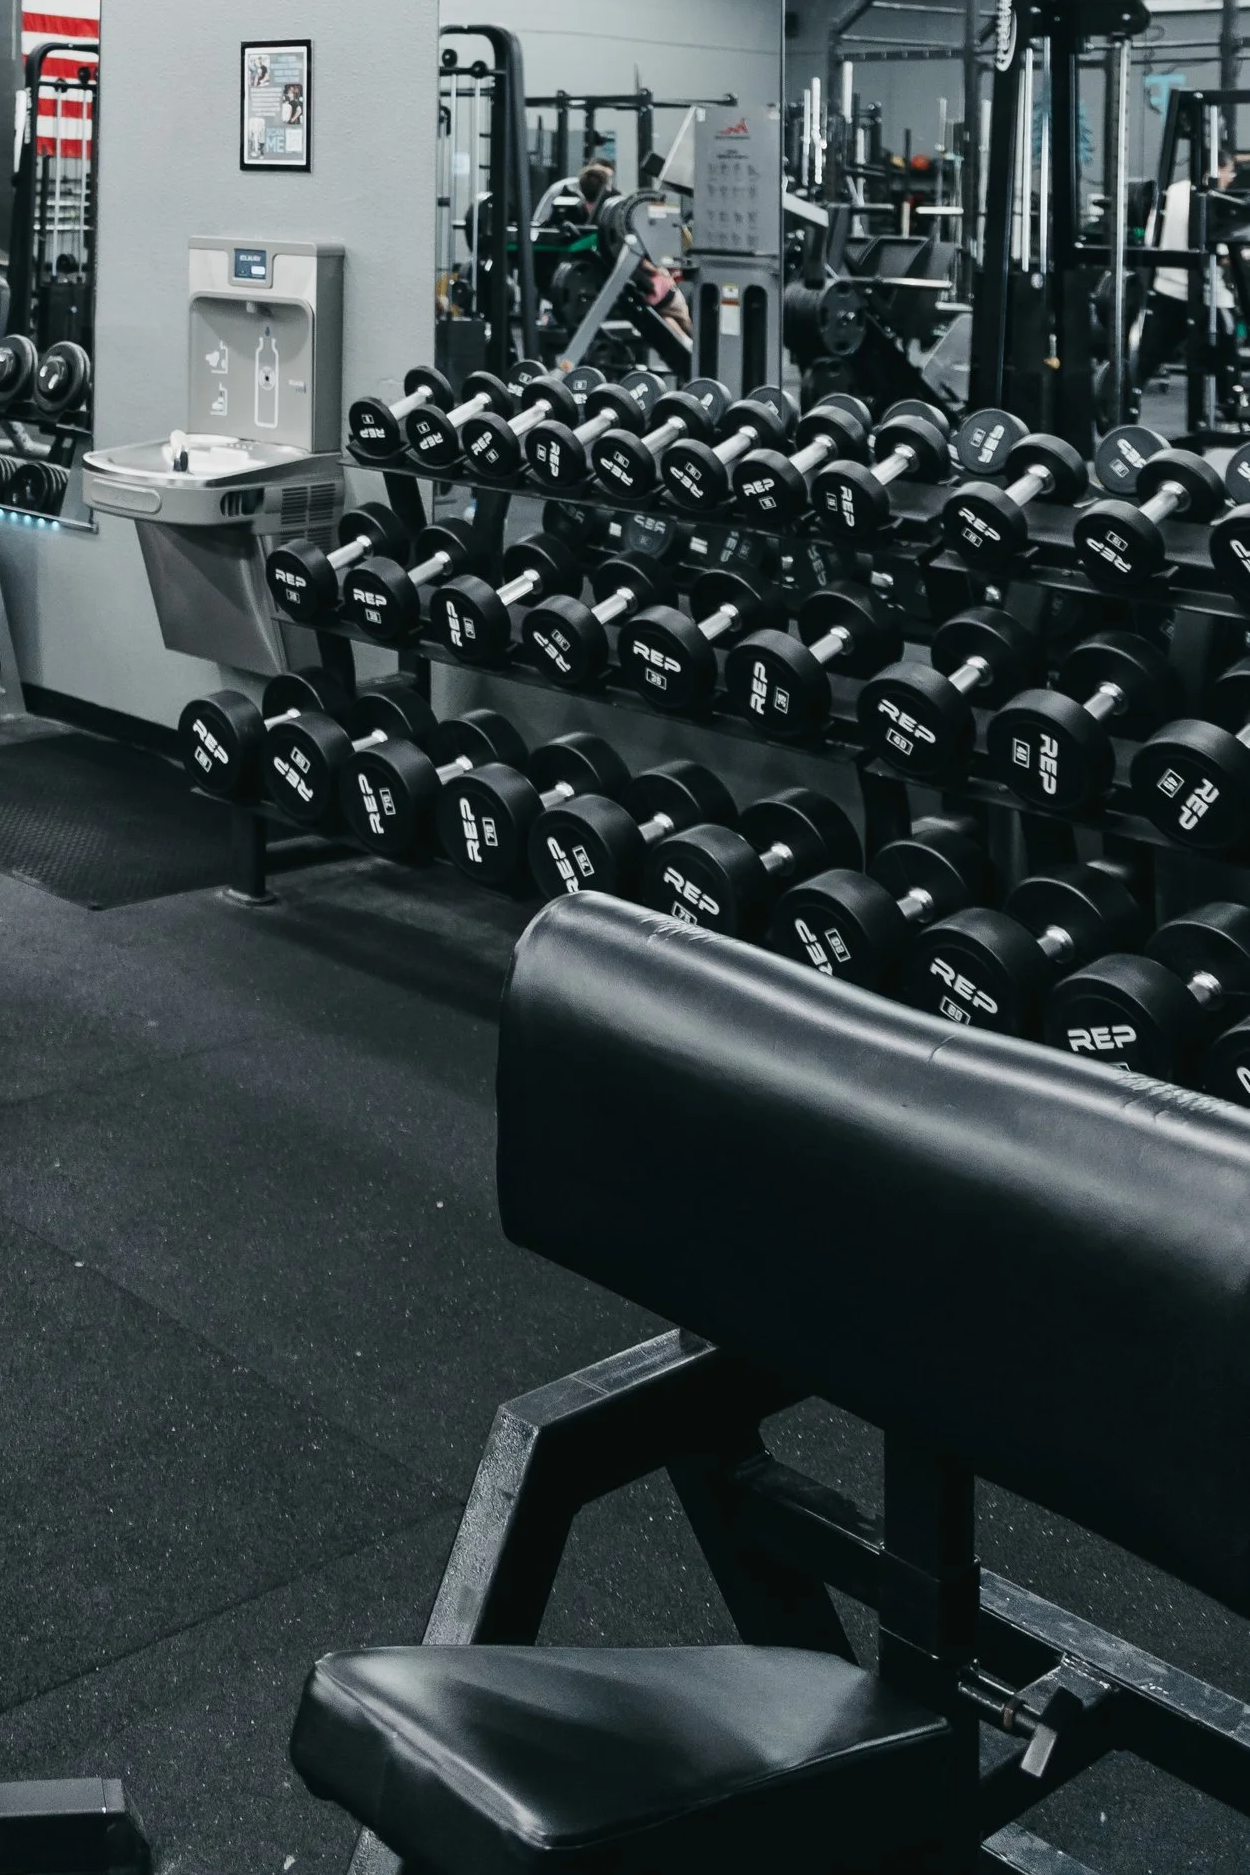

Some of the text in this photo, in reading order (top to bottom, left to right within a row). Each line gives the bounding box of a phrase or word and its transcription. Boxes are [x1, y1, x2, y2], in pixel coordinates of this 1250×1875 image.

[266, 136, 285, 153] ME
[359, 427, 386, 439] REP
[419, 432, 444, 450] REP
[472, 432, 492, 457] REP
[549, 441, 561, 477] REP
[600, 457, 634, 486] REP
[669, 466, 704, 499] REP
[742, 478, 775, 497] REP
[840, 485, 855, 527] REP
[959, 508, 1001, 542] REP
[1086, 537, 1132, 573] REP
[275, 568, 307, 588] REP
[353, 588, 387, 607] REP
[446, 600, 464, 647] REP
[533, 631, 571, 673] REP
[633, 640, 681, 673] REP
[750, 661, 768, 715] REP
[878, 699, 936, 744] REP
[192, 719, 229, 764] REP
[273, 756, 314, 802] REP
[1039, 733, 1059, 795] REP
[358, 773, 385, 834] REP
[1178, 777, 1219, 830] REP
[459, 797, 482, 863] REP
[547, 837, 579, 894] REP
[663, 867, 720, 916] REP
[930, 958, 998, 1015] REP
[1067, 1025, 1137, 1051] REP
